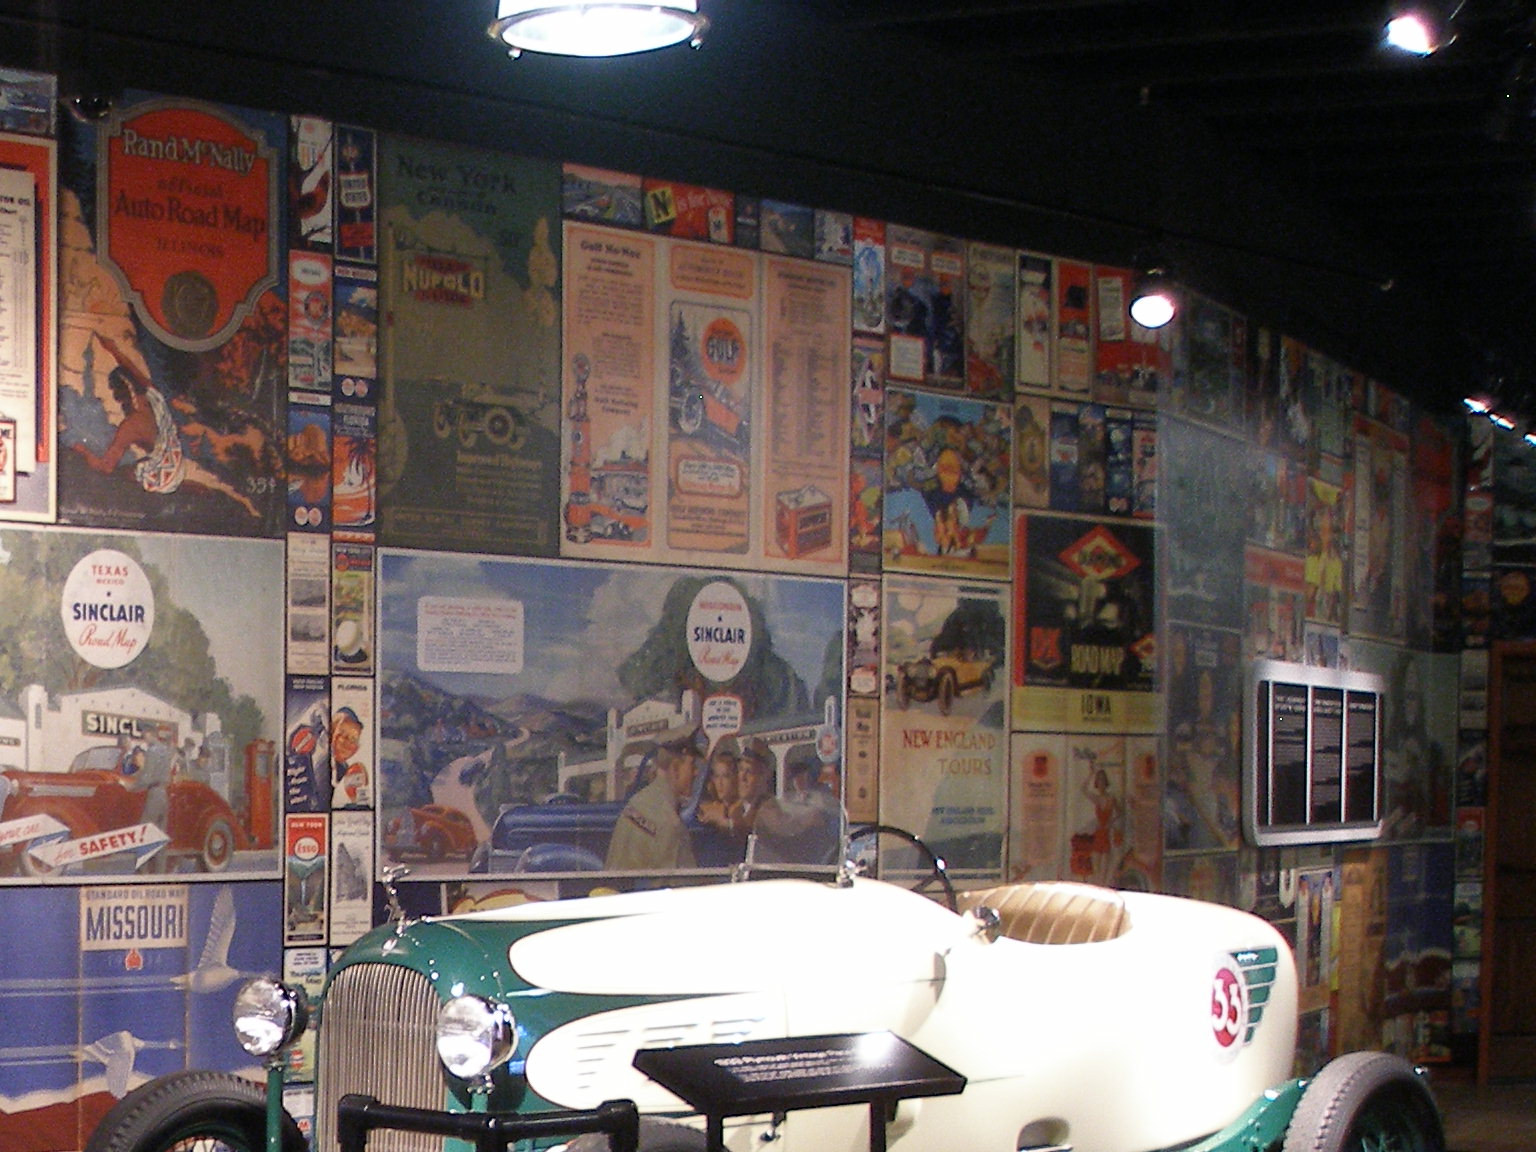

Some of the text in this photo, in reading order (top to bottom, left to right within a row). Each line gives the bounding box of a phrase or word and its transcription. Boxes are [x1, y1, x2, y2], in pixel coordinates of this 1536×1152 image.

[123, 129, 180, 162] Rand
[116, 190, 164, 222] Auto
[223, 205, 265, 243] Map
[91, 564, 129, 577] TEXAS
[72, 602, 145, 623] SINCLAIR
[694, 626, 746, 645] SINCLAIR
[86, 713, 144, 737] SINCL
[903, 730, 996, 749] NEW ENGLAND
[936, 758, 992, 775] TOURS
[79, 825, 147, 856] SAFETY!
[86, 904, 184, 941] MISSOURI
